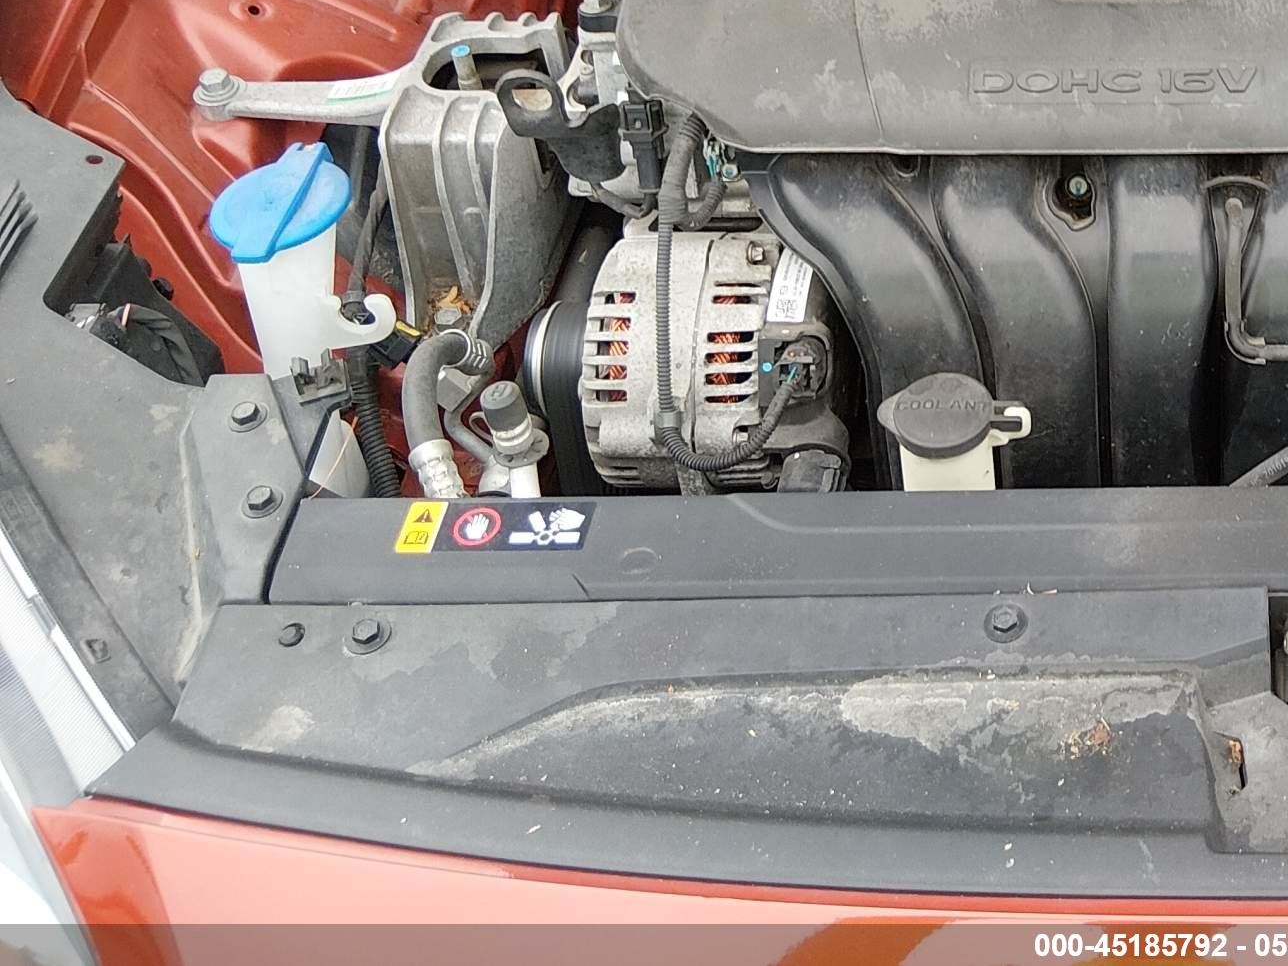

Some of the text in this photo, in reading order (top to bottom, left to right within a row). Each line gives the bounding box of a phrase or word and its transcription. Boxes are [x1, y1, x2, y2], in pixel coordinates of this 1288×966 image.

[972, 66, 1258, 94] DOHC 16V
[896, 399, 988, 411] COOLANT
